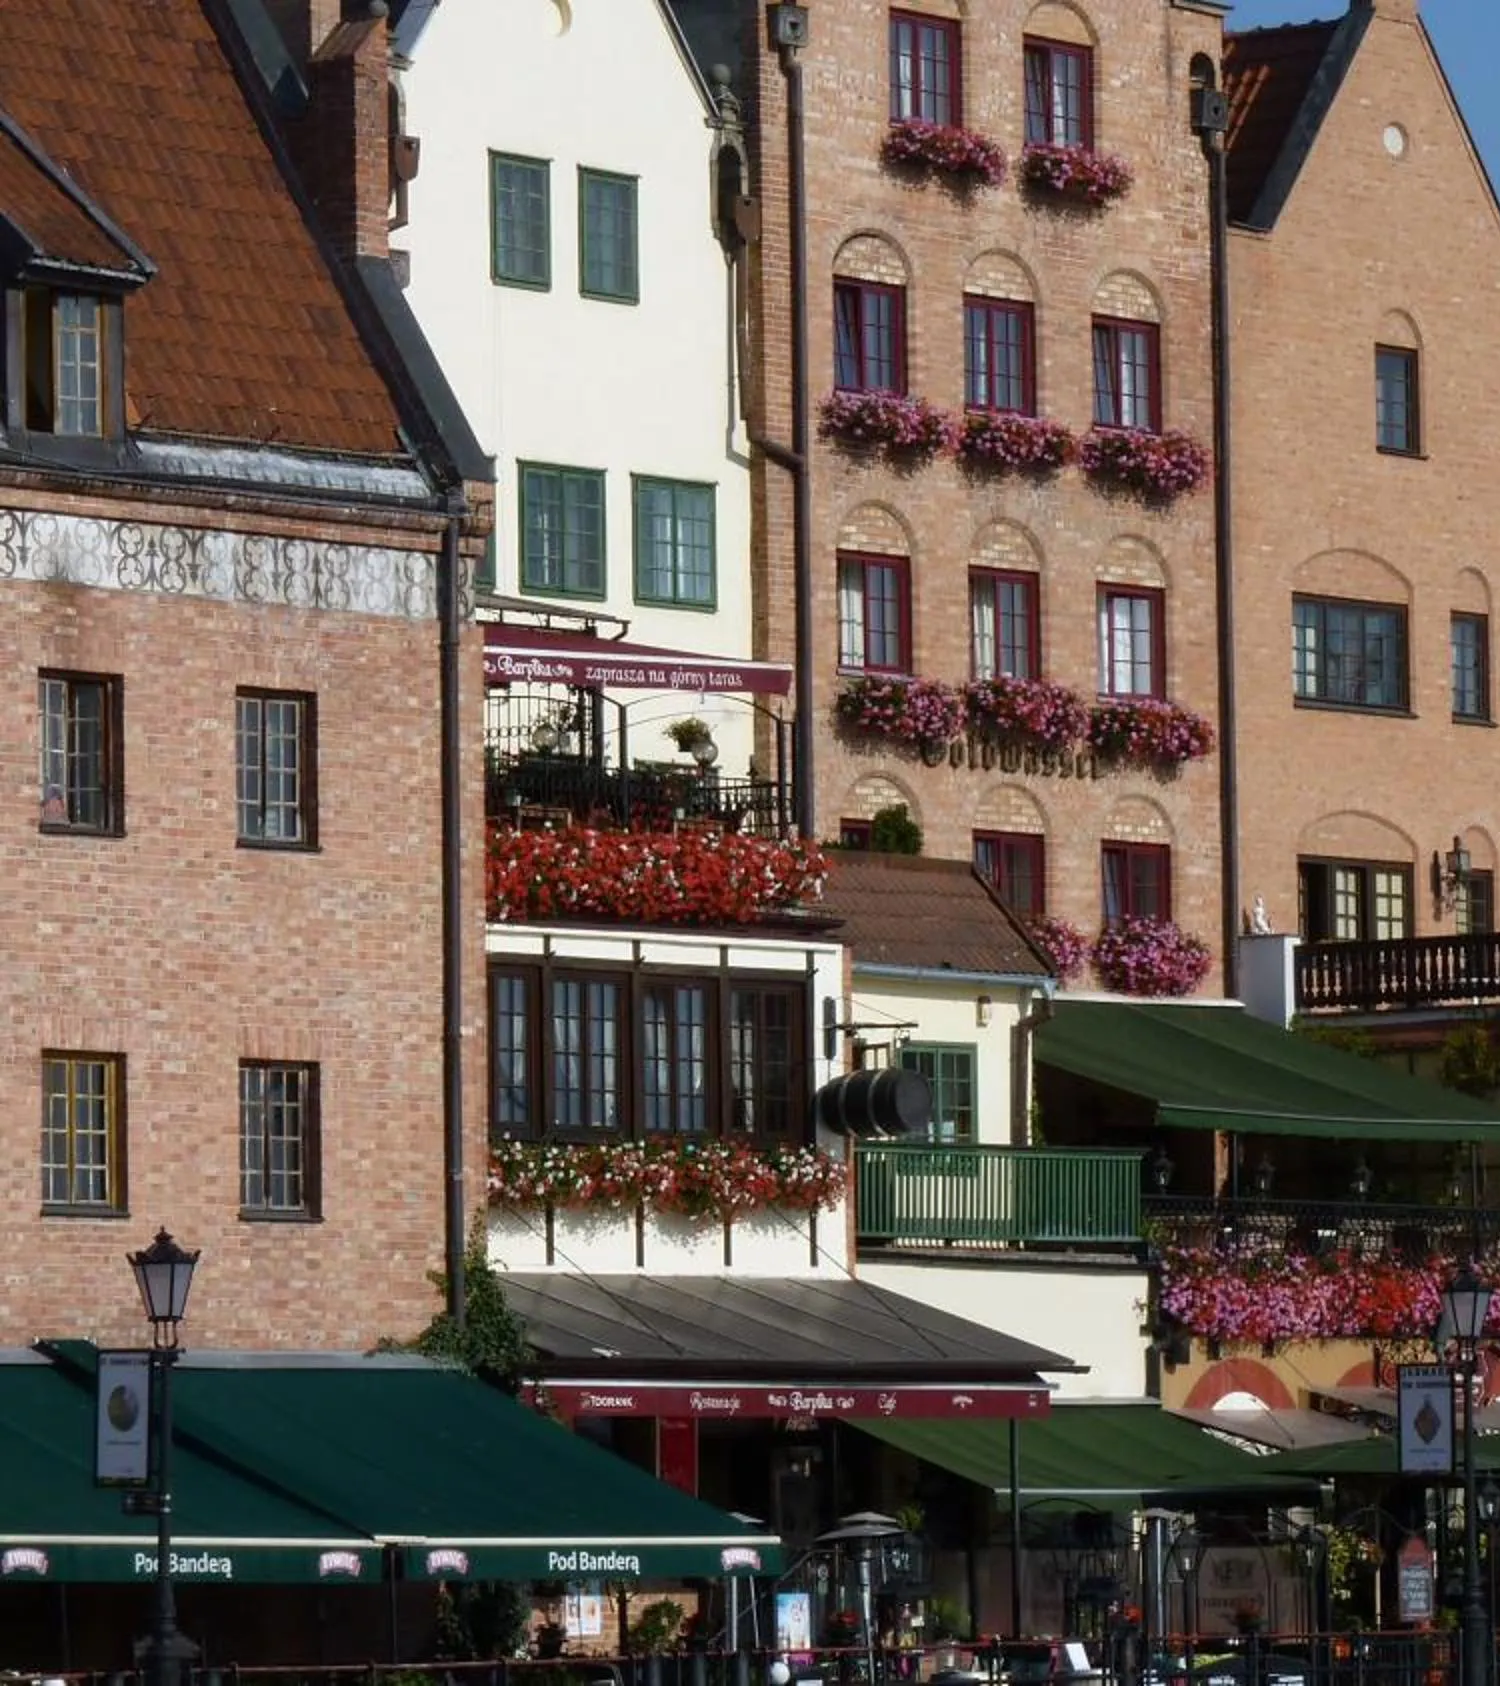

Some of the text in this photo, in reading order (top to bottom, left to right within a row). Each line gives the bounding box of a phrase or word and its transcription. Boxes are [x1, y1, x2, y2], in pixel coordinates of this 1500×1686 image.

[585, 666, 645, 686] zaprasza
[649, 672, 666, 683] na
[669, 666, 705, 690] górny
[709, 671, 743, 686] taras
[549, 1550, 640, 1575] Pod Banderą
